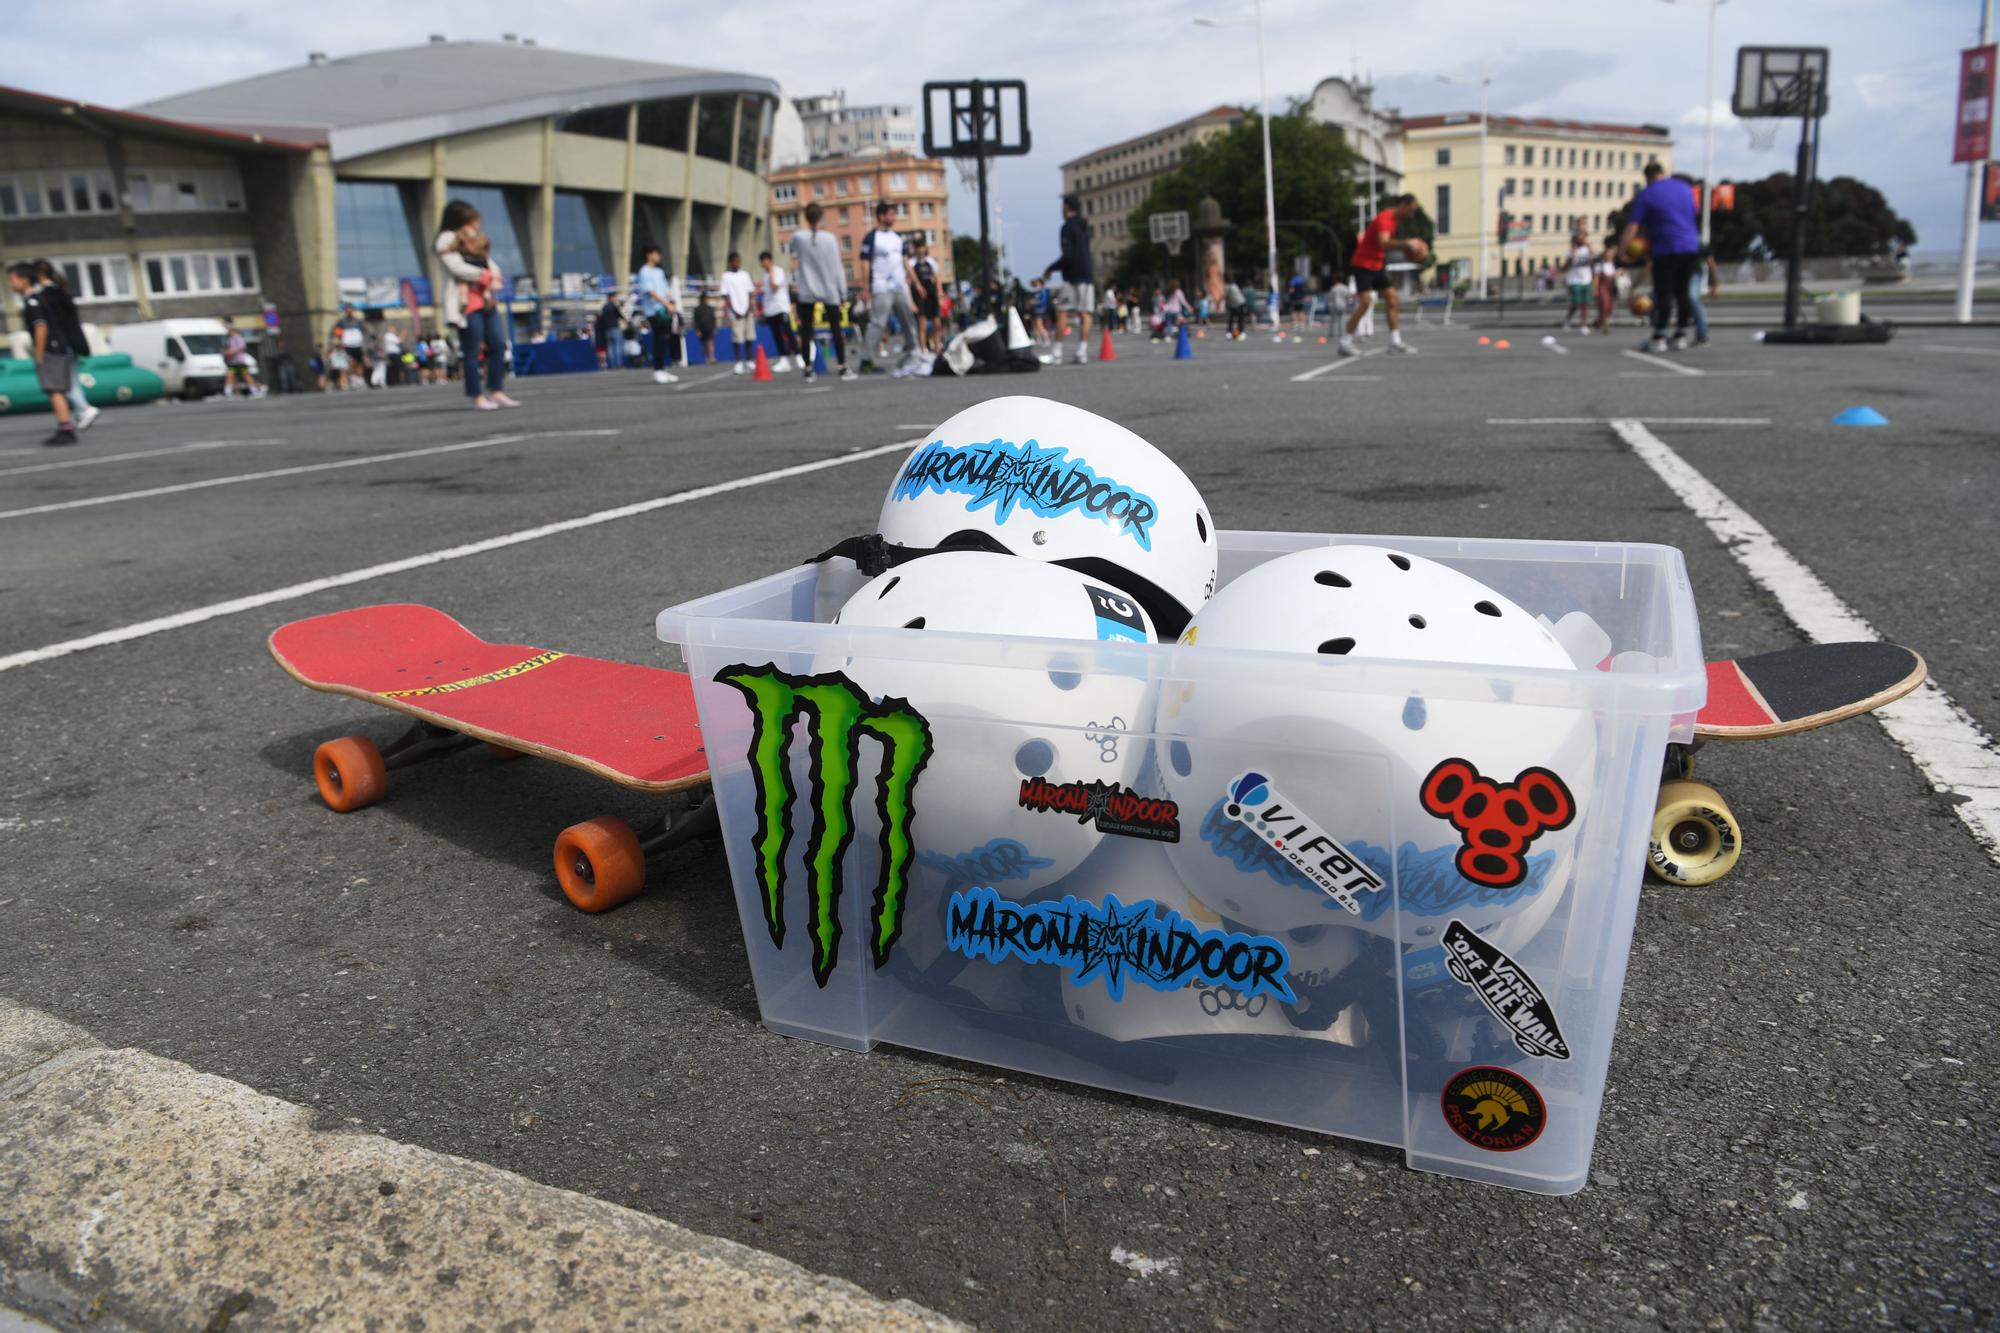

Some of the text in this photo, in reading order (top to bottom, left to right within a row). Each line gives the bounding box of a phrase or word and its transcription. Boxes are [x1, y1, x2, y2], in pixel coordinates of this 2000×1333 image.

[1029, 462, 1154, 543] INDOOR
[1020, 780, 1177, 826] MARONA INDOOR
[1288, 853, 1305, 866] DE
[1305, 866, 1339, 894] DIEGO
[1338, 894, 1357, 912] S.L.
[952, 898, 1288, 997] MARONA INDOOR
[1480, 969, 1521, 1014] THE
[1492, 955, 1542, 1008] VANS
[1447, 1104, 1536, 1147] PRETORIAN
